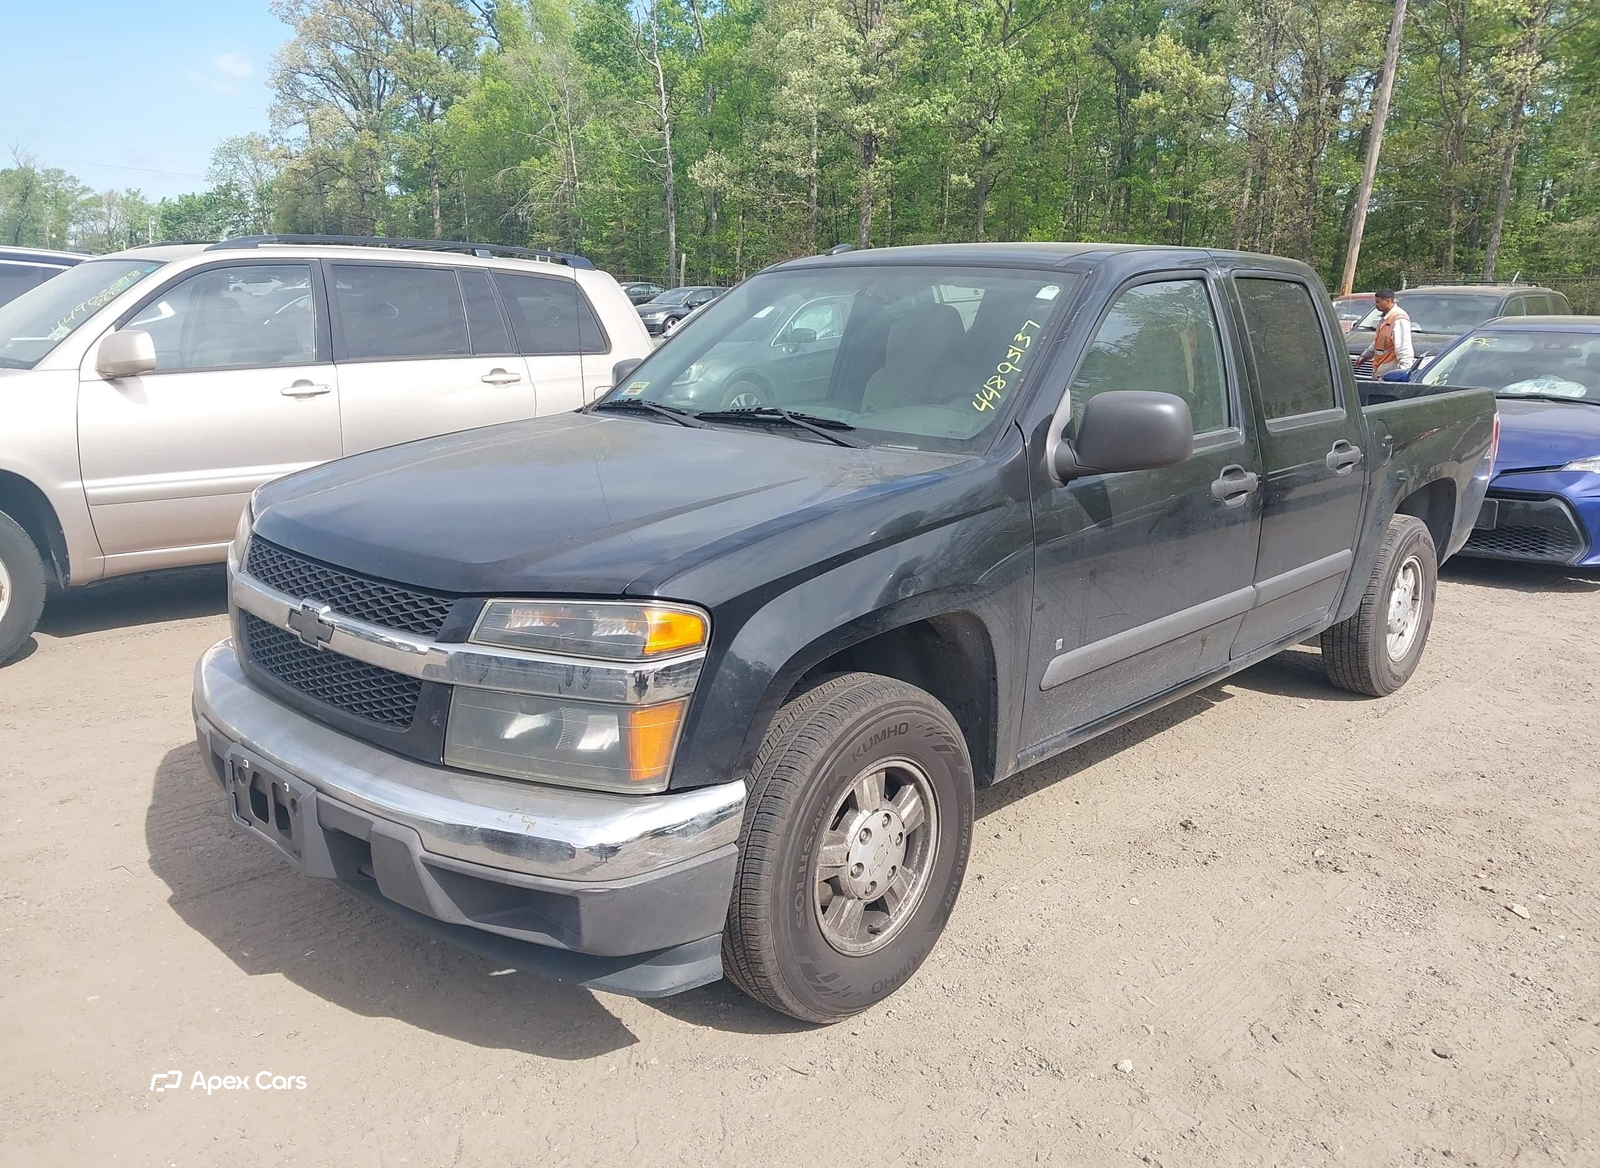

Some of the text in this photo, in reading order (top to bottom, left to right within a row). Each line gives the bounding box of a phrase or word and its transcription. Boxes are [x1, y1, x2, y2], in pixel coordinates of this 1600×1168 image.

[972, 319, 1041, 411] 44895137
[851, 721, 909, 763] KUMHO
[794, 836, 813, 928] SOLUS
